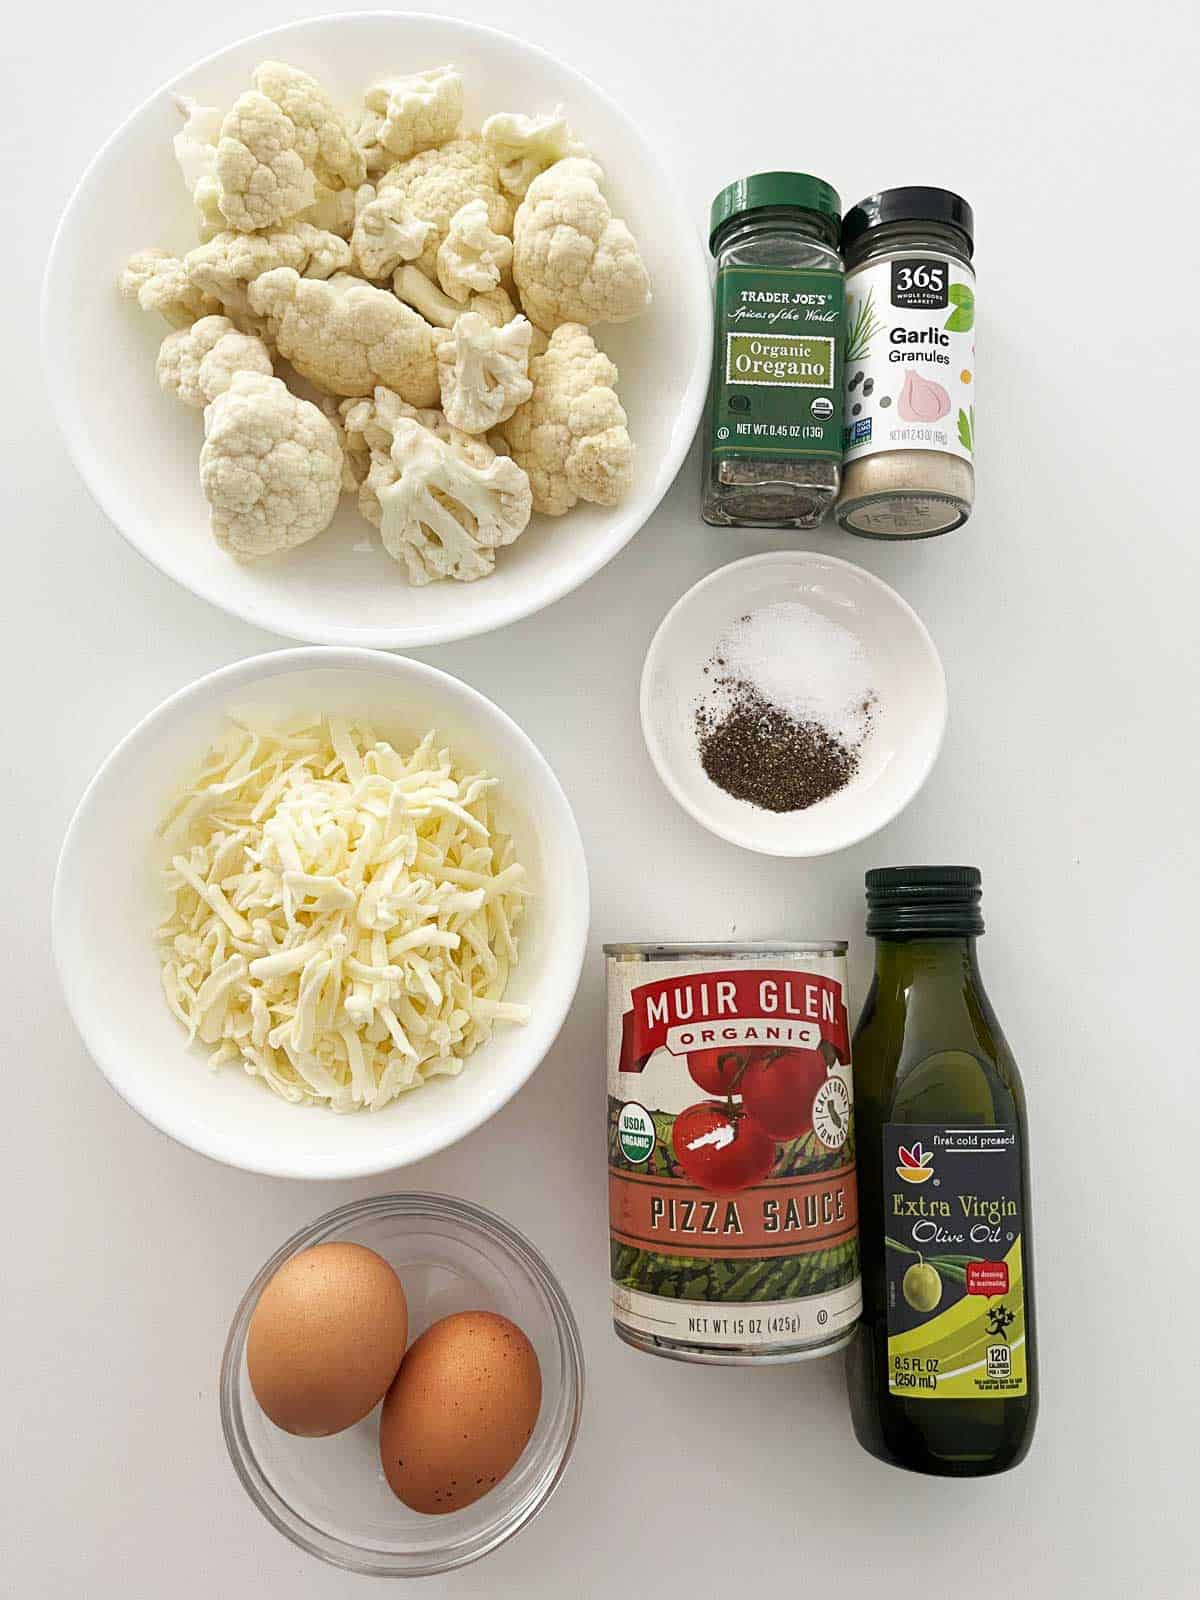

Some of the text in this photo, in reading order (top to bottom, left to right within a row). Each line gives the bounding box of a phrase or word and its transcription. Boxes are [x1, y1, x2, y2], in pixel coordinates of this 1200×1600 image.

[897, 265, 943, 291] 365
[741, 291, 826, 305] TRADER JOE'S
[728, 306, 839, 324] Spices of the World
[889, 327, 950, 347] Garlic
[750, 342, 811, 358] Organic
[888, 350, 950, 365] Granules
[736, 355, 825, 377] Oregano
[737, 424, 751, 435] NET
[769, 425, 788, 437] 0.45
[789, 425, 800, 437] OZ
[802, 426, 824, 439] (13G)
[646, 980, 836, 1029] MUIR GLEN
[680, 1027, 811, 1045] ORGANIC
[624, 1116, 645, 1131] USDA
[622, 1134, 650, 1148] ORGANIC
[933, 1135, 1015, 1148] first cold pressed
[650, 1189, 847, 1235] PIZZA SAUCE
[891, 1193, 1017, 1225] Extra Virgin
[912, 1219, 1002, 1243] Olive Oil
[688, 1315, 801, 1334] NET WT 15 OZ (425g)
[990, 1348, 1008, 1362] 120
[894, 1356, 939, 1372] 8.5 FL OZ
[895, 1374, 937, 1390] (250 mL)
